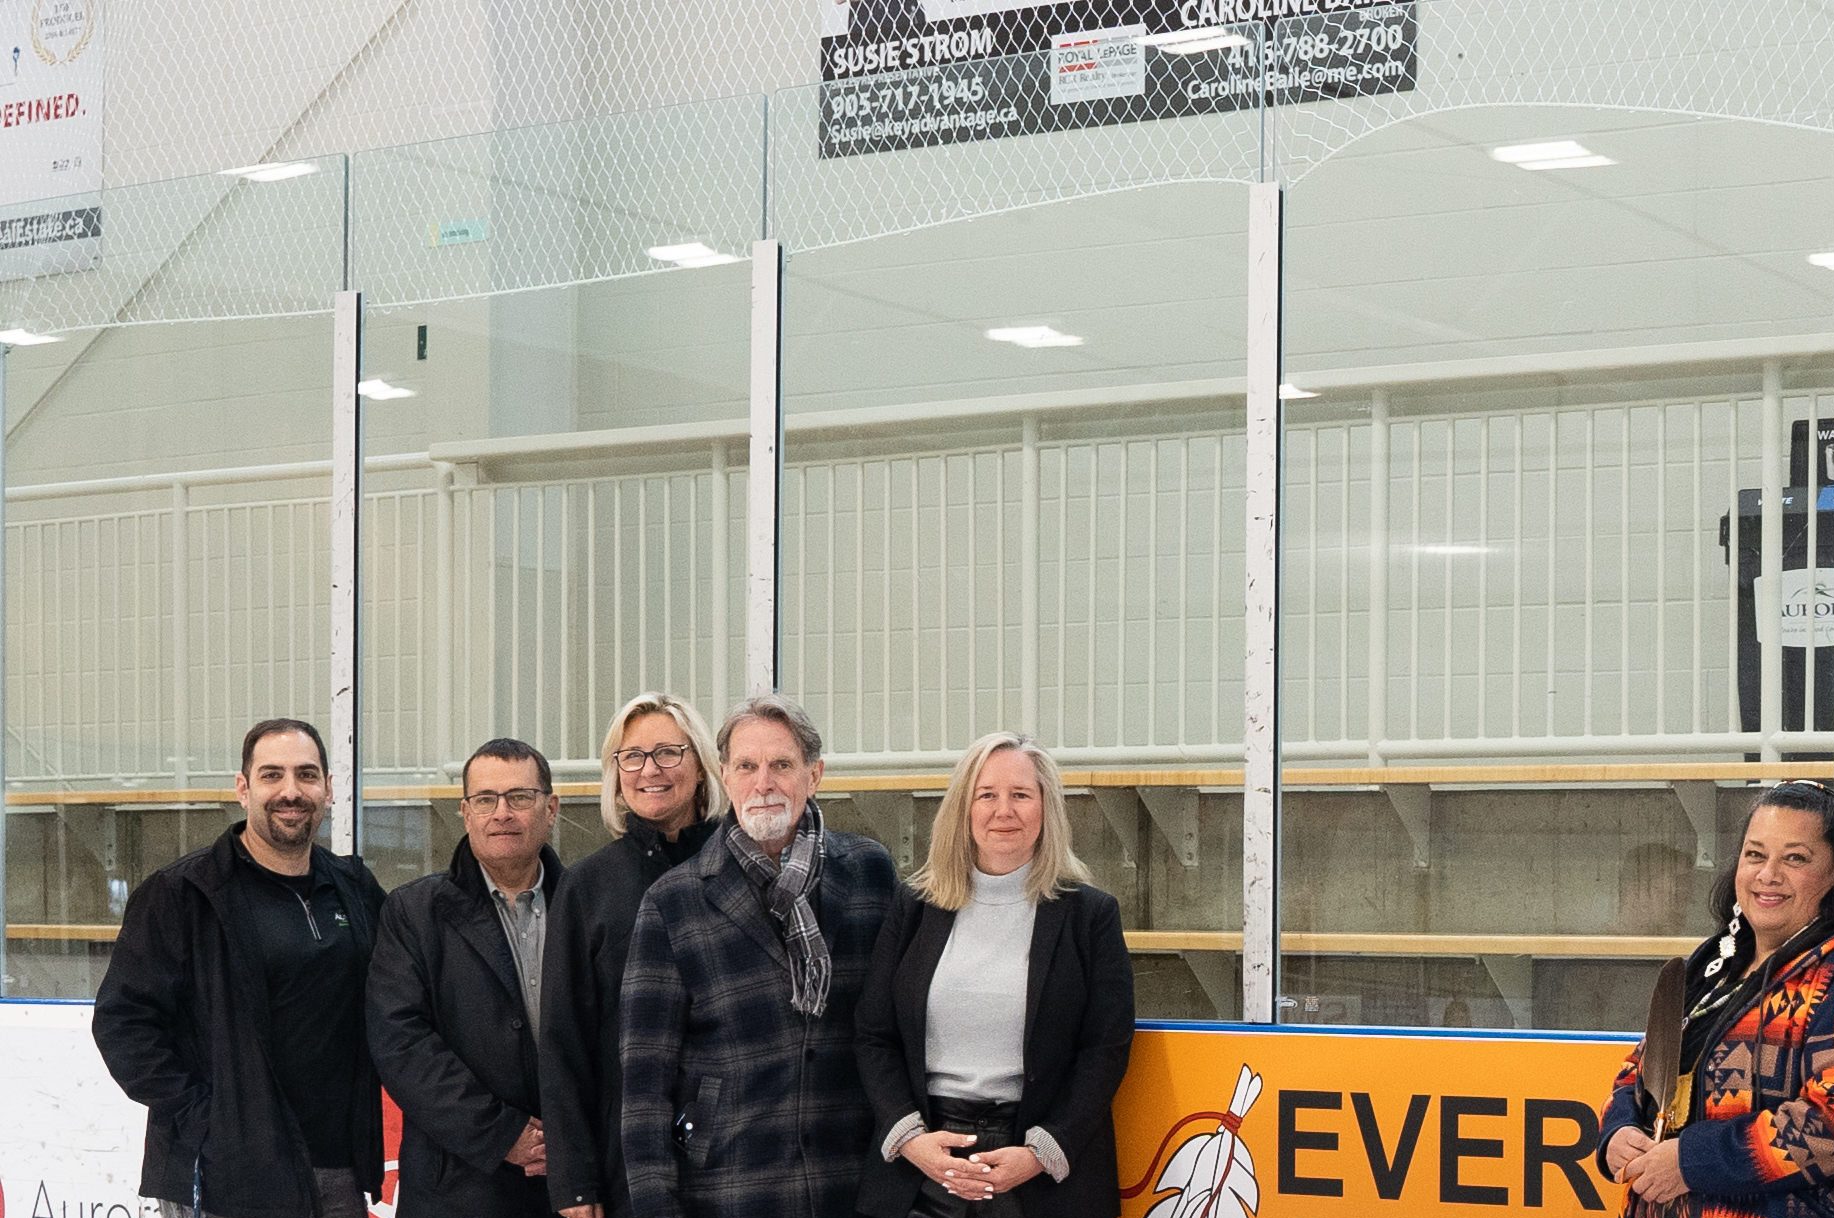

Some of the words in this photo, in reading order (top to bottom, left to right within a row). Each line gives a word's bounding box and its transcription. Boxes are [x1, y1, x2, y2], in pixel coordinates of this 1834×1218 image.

[833, 40, 900, 74] SUSIE
[905, 27, 992, 65] STROM
[1228, 25, 1403, 68] 416-788-2700
[0, 93, 86, 128] EFINED.
[831, 77, 984, 119] 905-717-1945
[830, 105, 1018, 144] Susie@keyadvantage.ca
[1277, 1089, 1606, 1211] EVER
